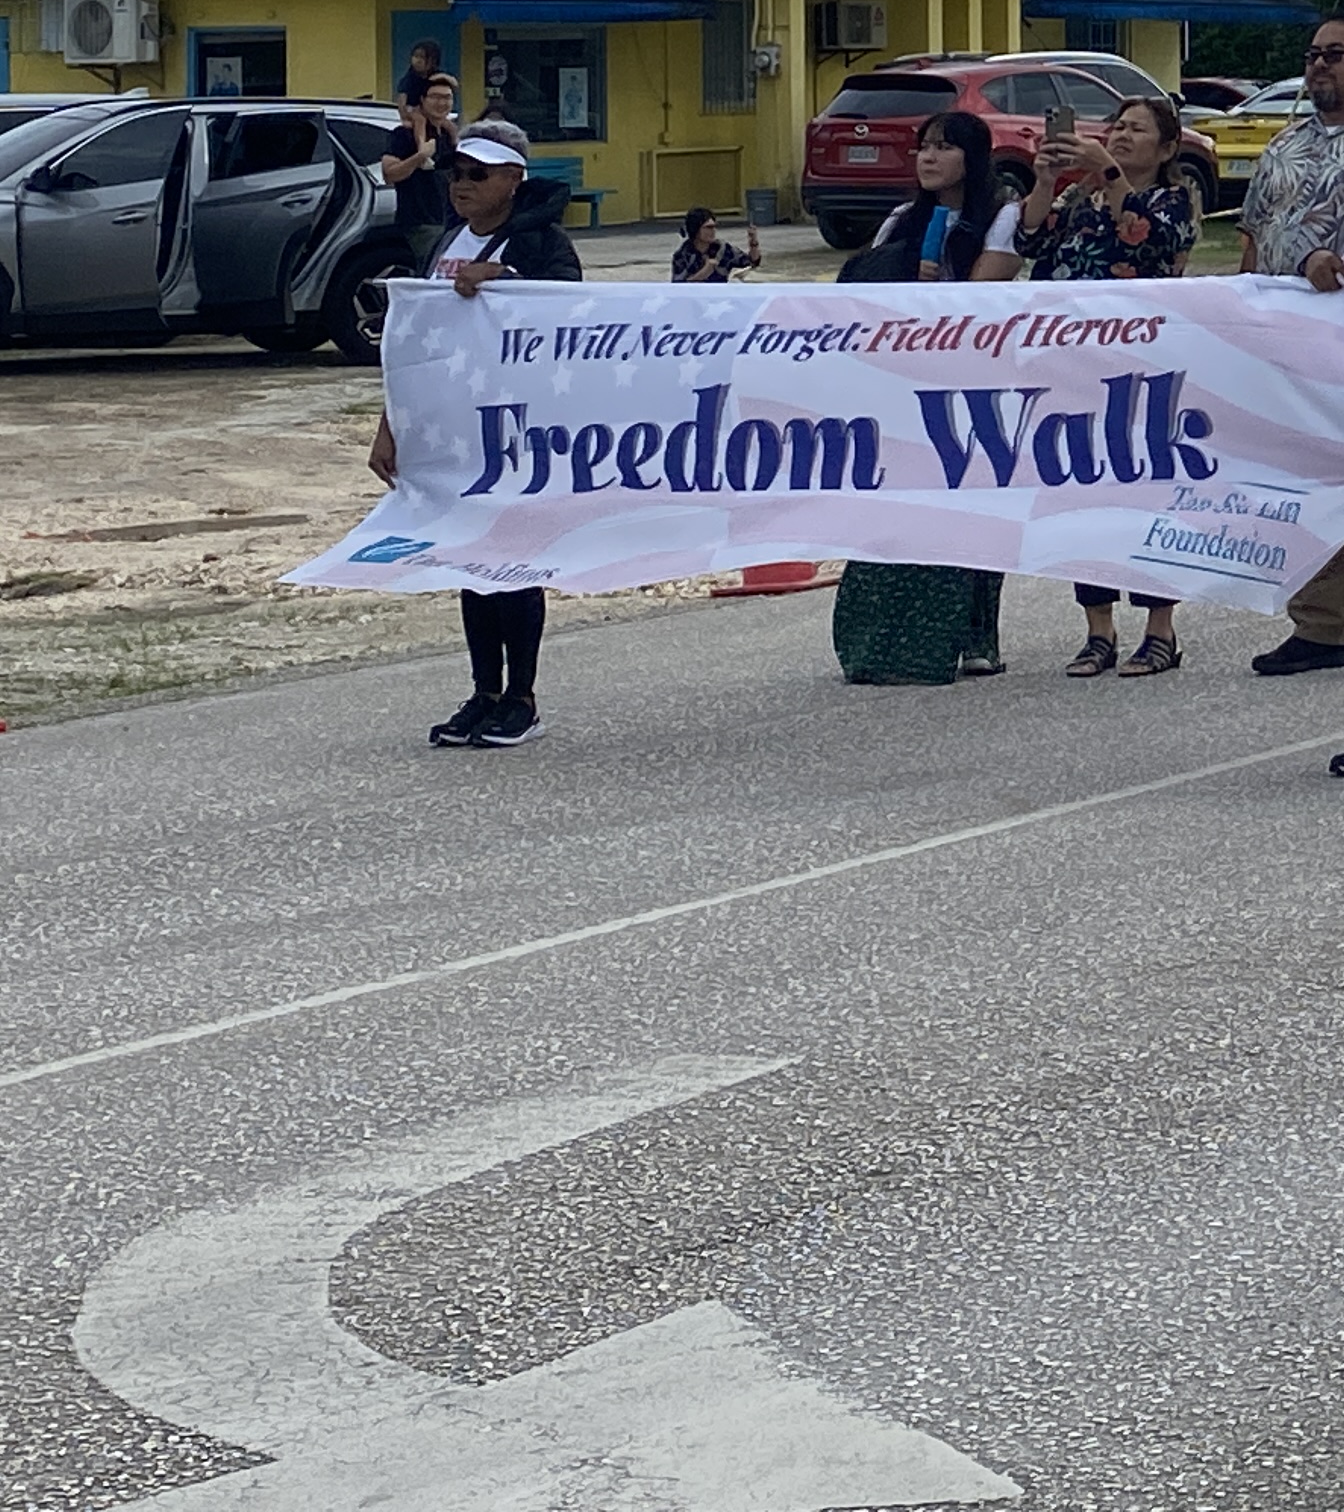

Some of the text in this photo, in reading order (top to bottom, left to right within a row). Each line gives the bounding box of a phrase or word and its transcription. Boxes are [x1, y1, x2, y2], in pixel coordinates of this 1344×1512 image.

[500, 312, 1166, 365] We Will Never Forget: Field of Heroes
[460, 370, 1218, 497] Freedom Walk
[1143, 517, 1287, 571] Foundation
